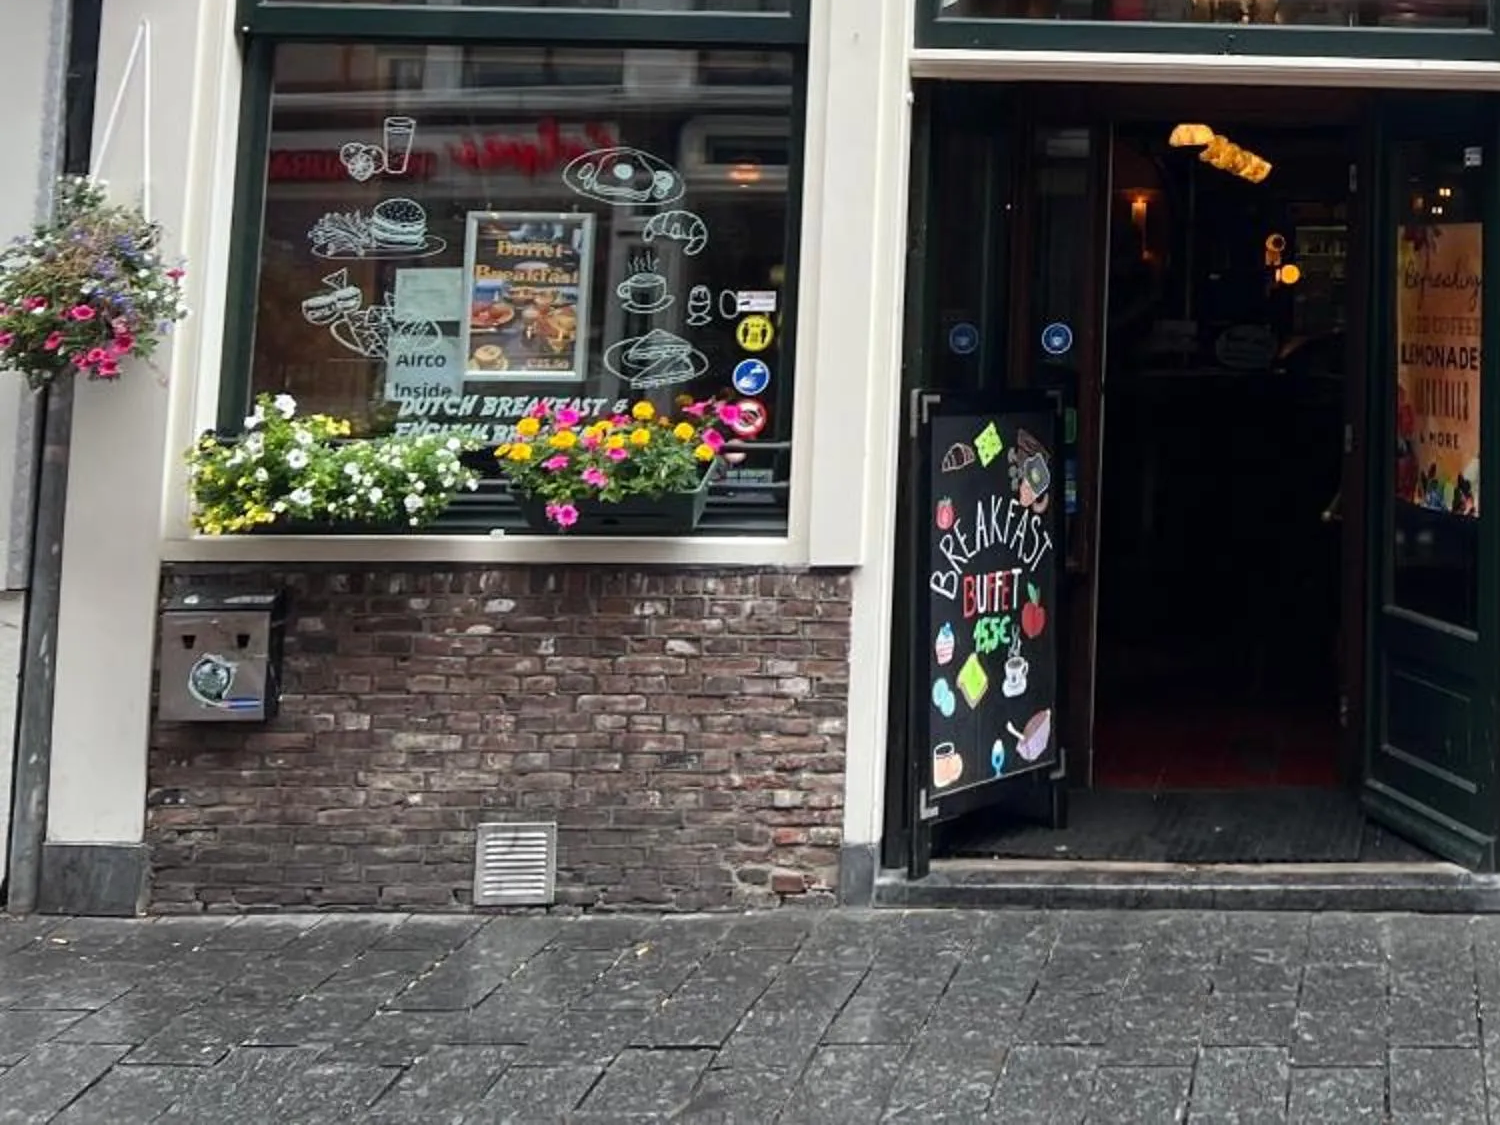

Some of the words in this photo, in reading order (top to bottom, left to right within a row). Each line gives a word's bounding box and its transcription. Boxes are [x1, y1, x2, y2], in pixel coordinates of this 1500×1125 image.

[396, 354, 447, 368] Airco
[394, 382, 453, 398] Inside
[397, 394, 479, 416] DUTCH
[480, 396, 608, 417] BREAKFAST
[612, 398, 629, 414] &
[929, 494, 1053, 601] BREAKFAST
[963, 568, 1023, 618] BUFFET
